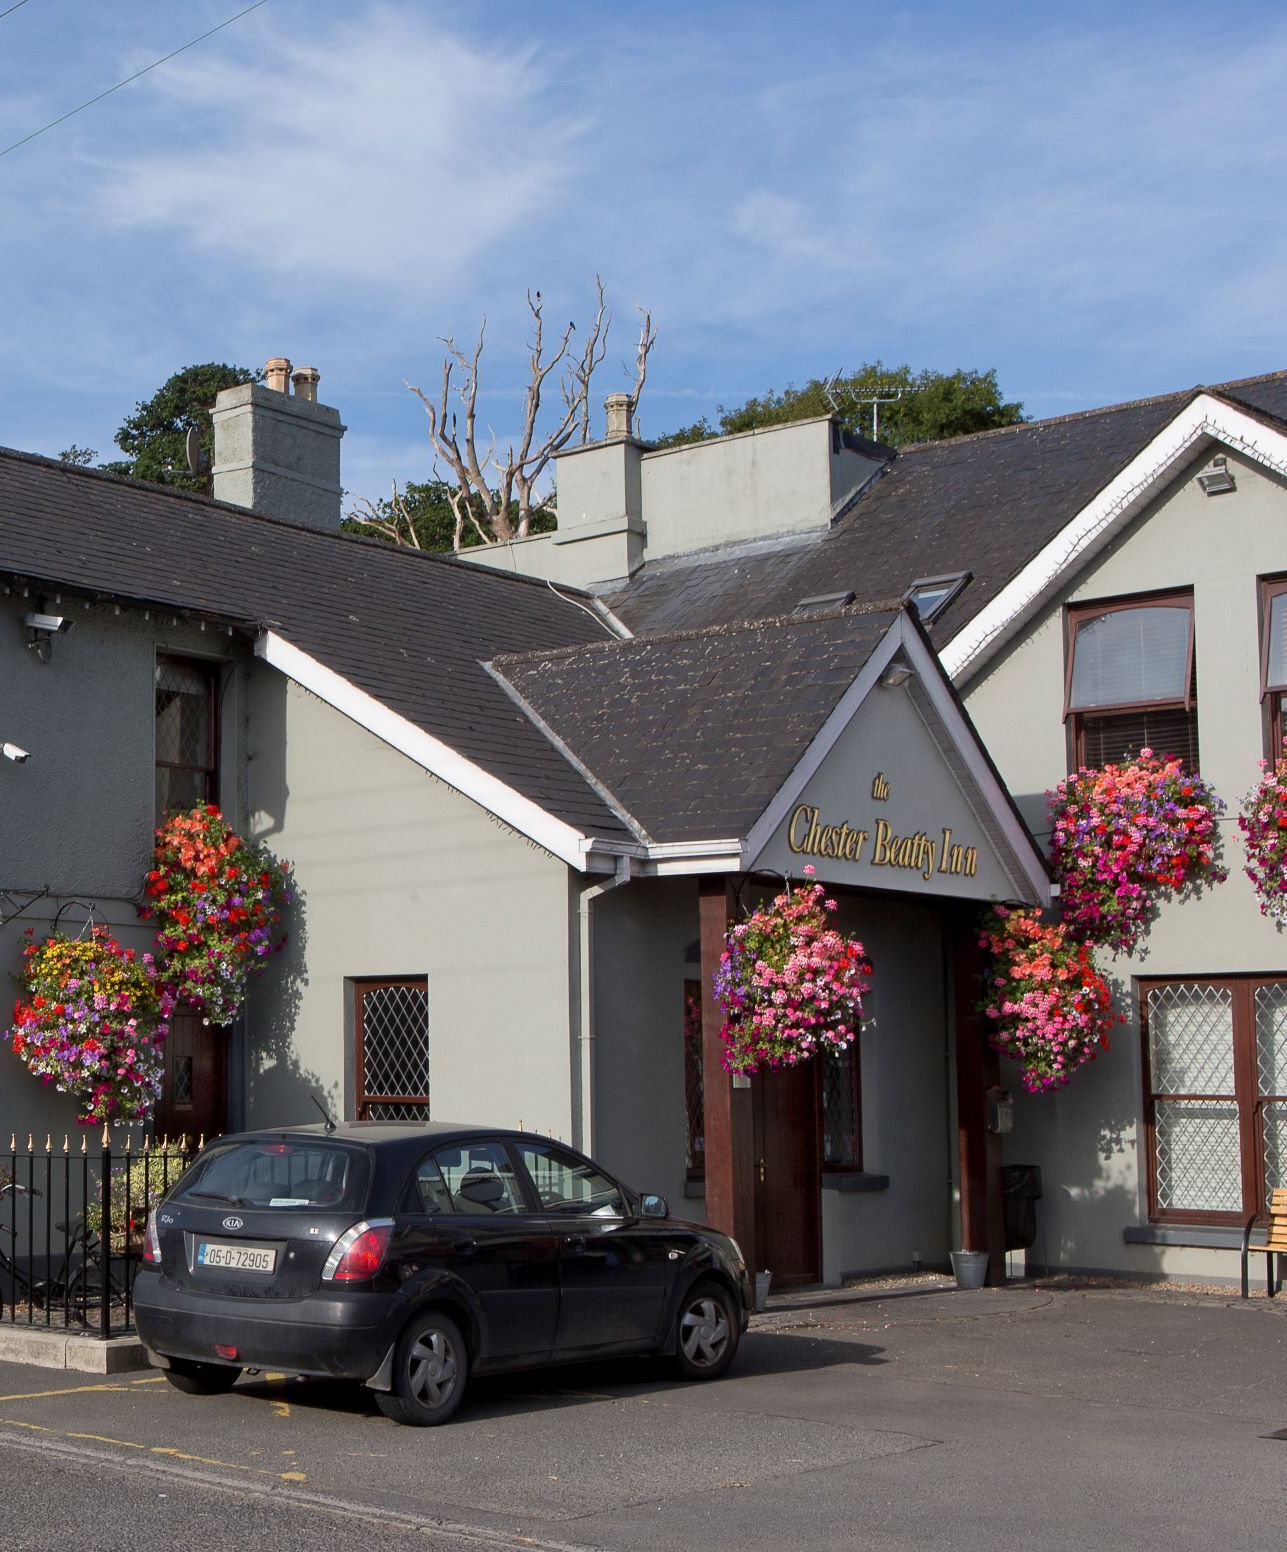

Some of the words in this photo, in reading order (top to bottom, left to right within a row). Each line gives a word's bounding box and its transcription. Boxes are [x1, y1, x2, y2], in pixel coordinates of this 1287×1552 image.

[871, 771, 891, 801] the
[789, 804, 869, 862] Chester
[872, 818, 936, 880] Beatty
[938, 828, 978, 876] Inn
[209, 1249, 270, 1269] 05-D-72905
